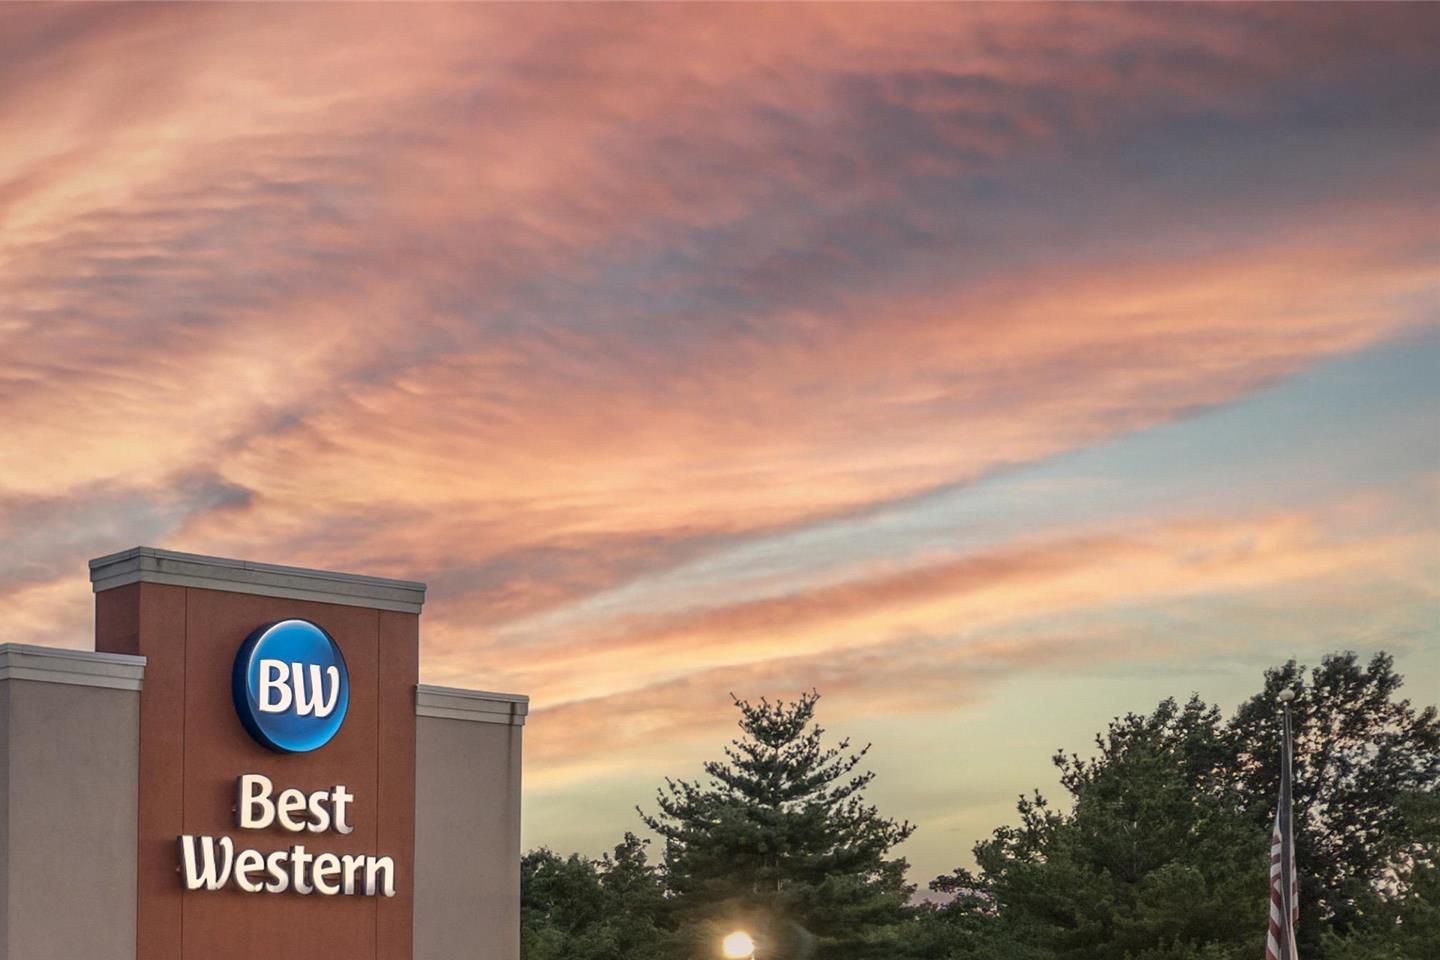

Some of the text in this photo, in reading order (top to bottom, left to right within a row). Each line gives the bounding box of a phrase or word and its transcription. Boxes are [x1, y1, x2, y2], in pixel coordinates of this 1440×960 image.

[258, 658, 341, 718] BW
[238, 773, 354, 834] Best
[179, 834, 397, 898] Western
